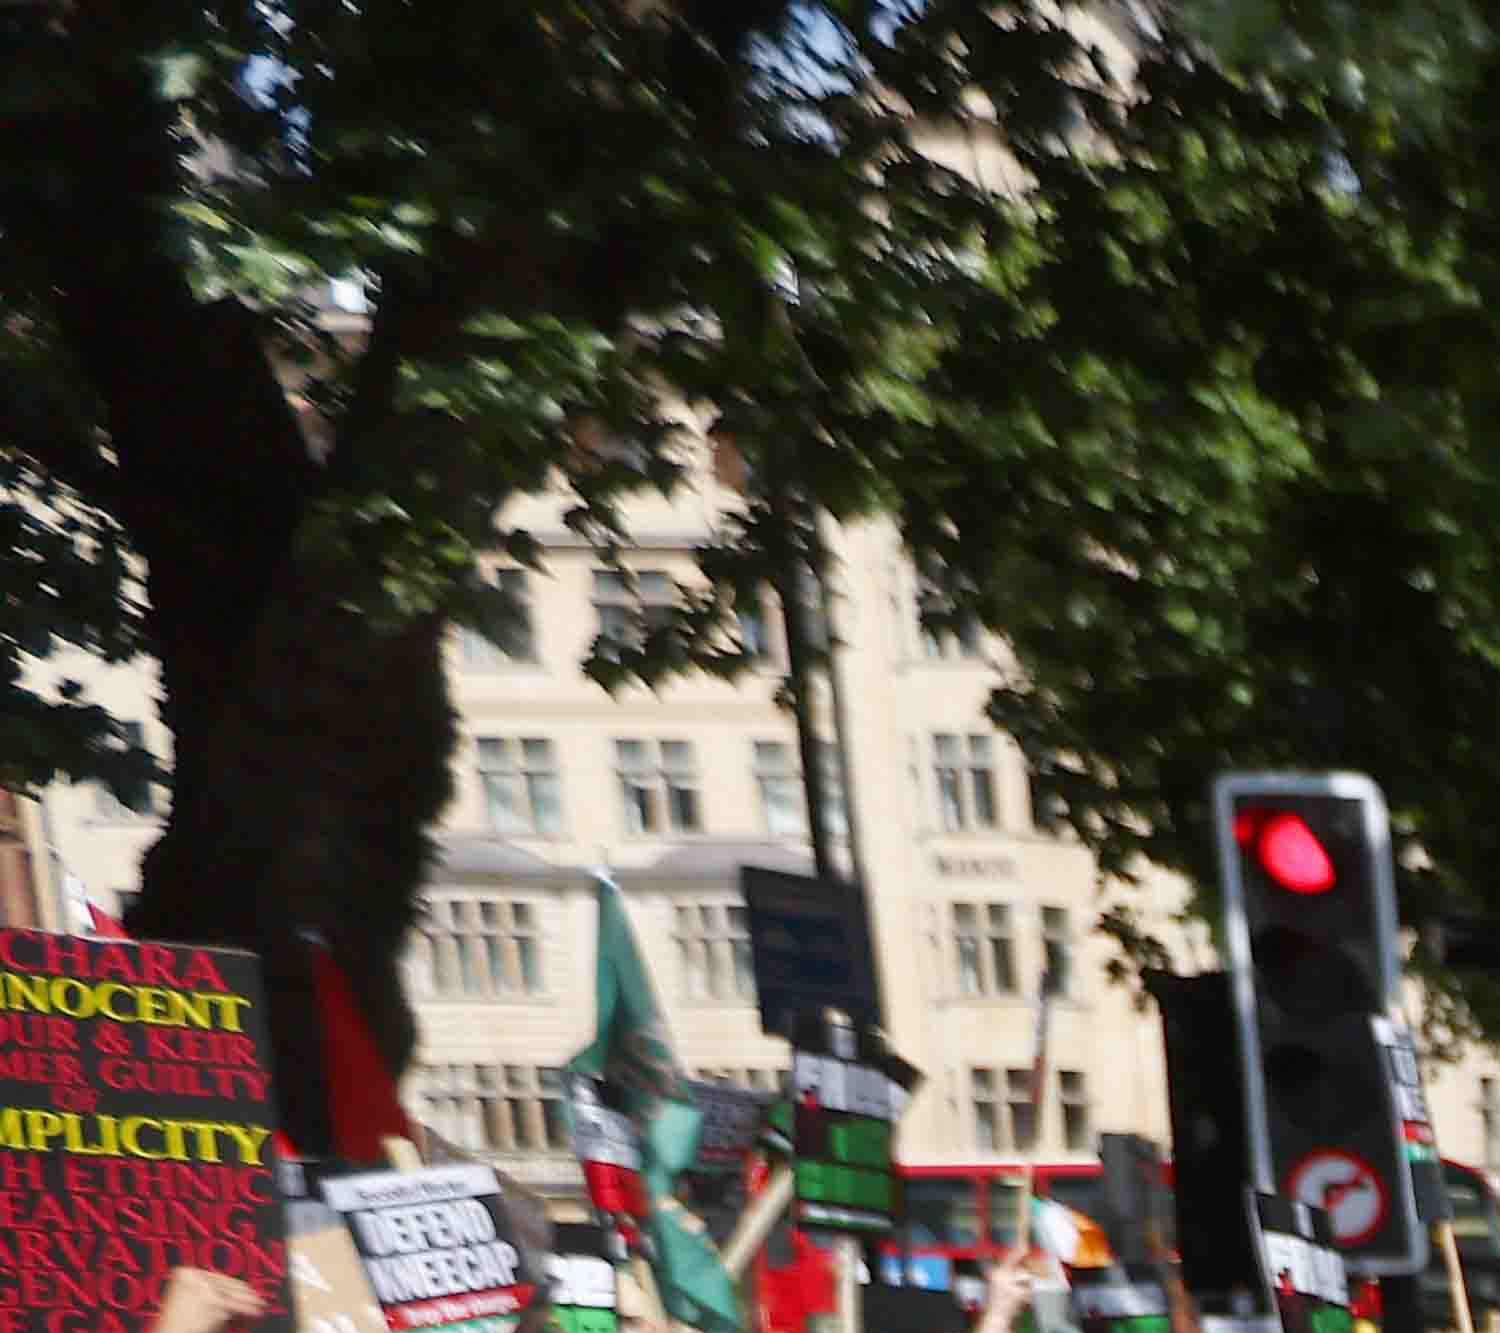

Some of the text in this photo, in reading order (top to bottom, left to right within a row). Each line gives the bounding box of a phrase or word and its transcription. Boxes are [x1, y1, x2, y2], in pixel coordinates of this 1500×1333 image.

[0, 927, 231, 993] CHARA
[0, 970, 252, 1032] NOCENT
[94, 1021, 133, 1055] &
[146, 1027, 258, 1068] KEIR
[98, 1058, 272, 1102] GUILTY
[64, 1157, 273, 1207] ETHNIC
[353, 1197, 496, 1257] DEFEND
